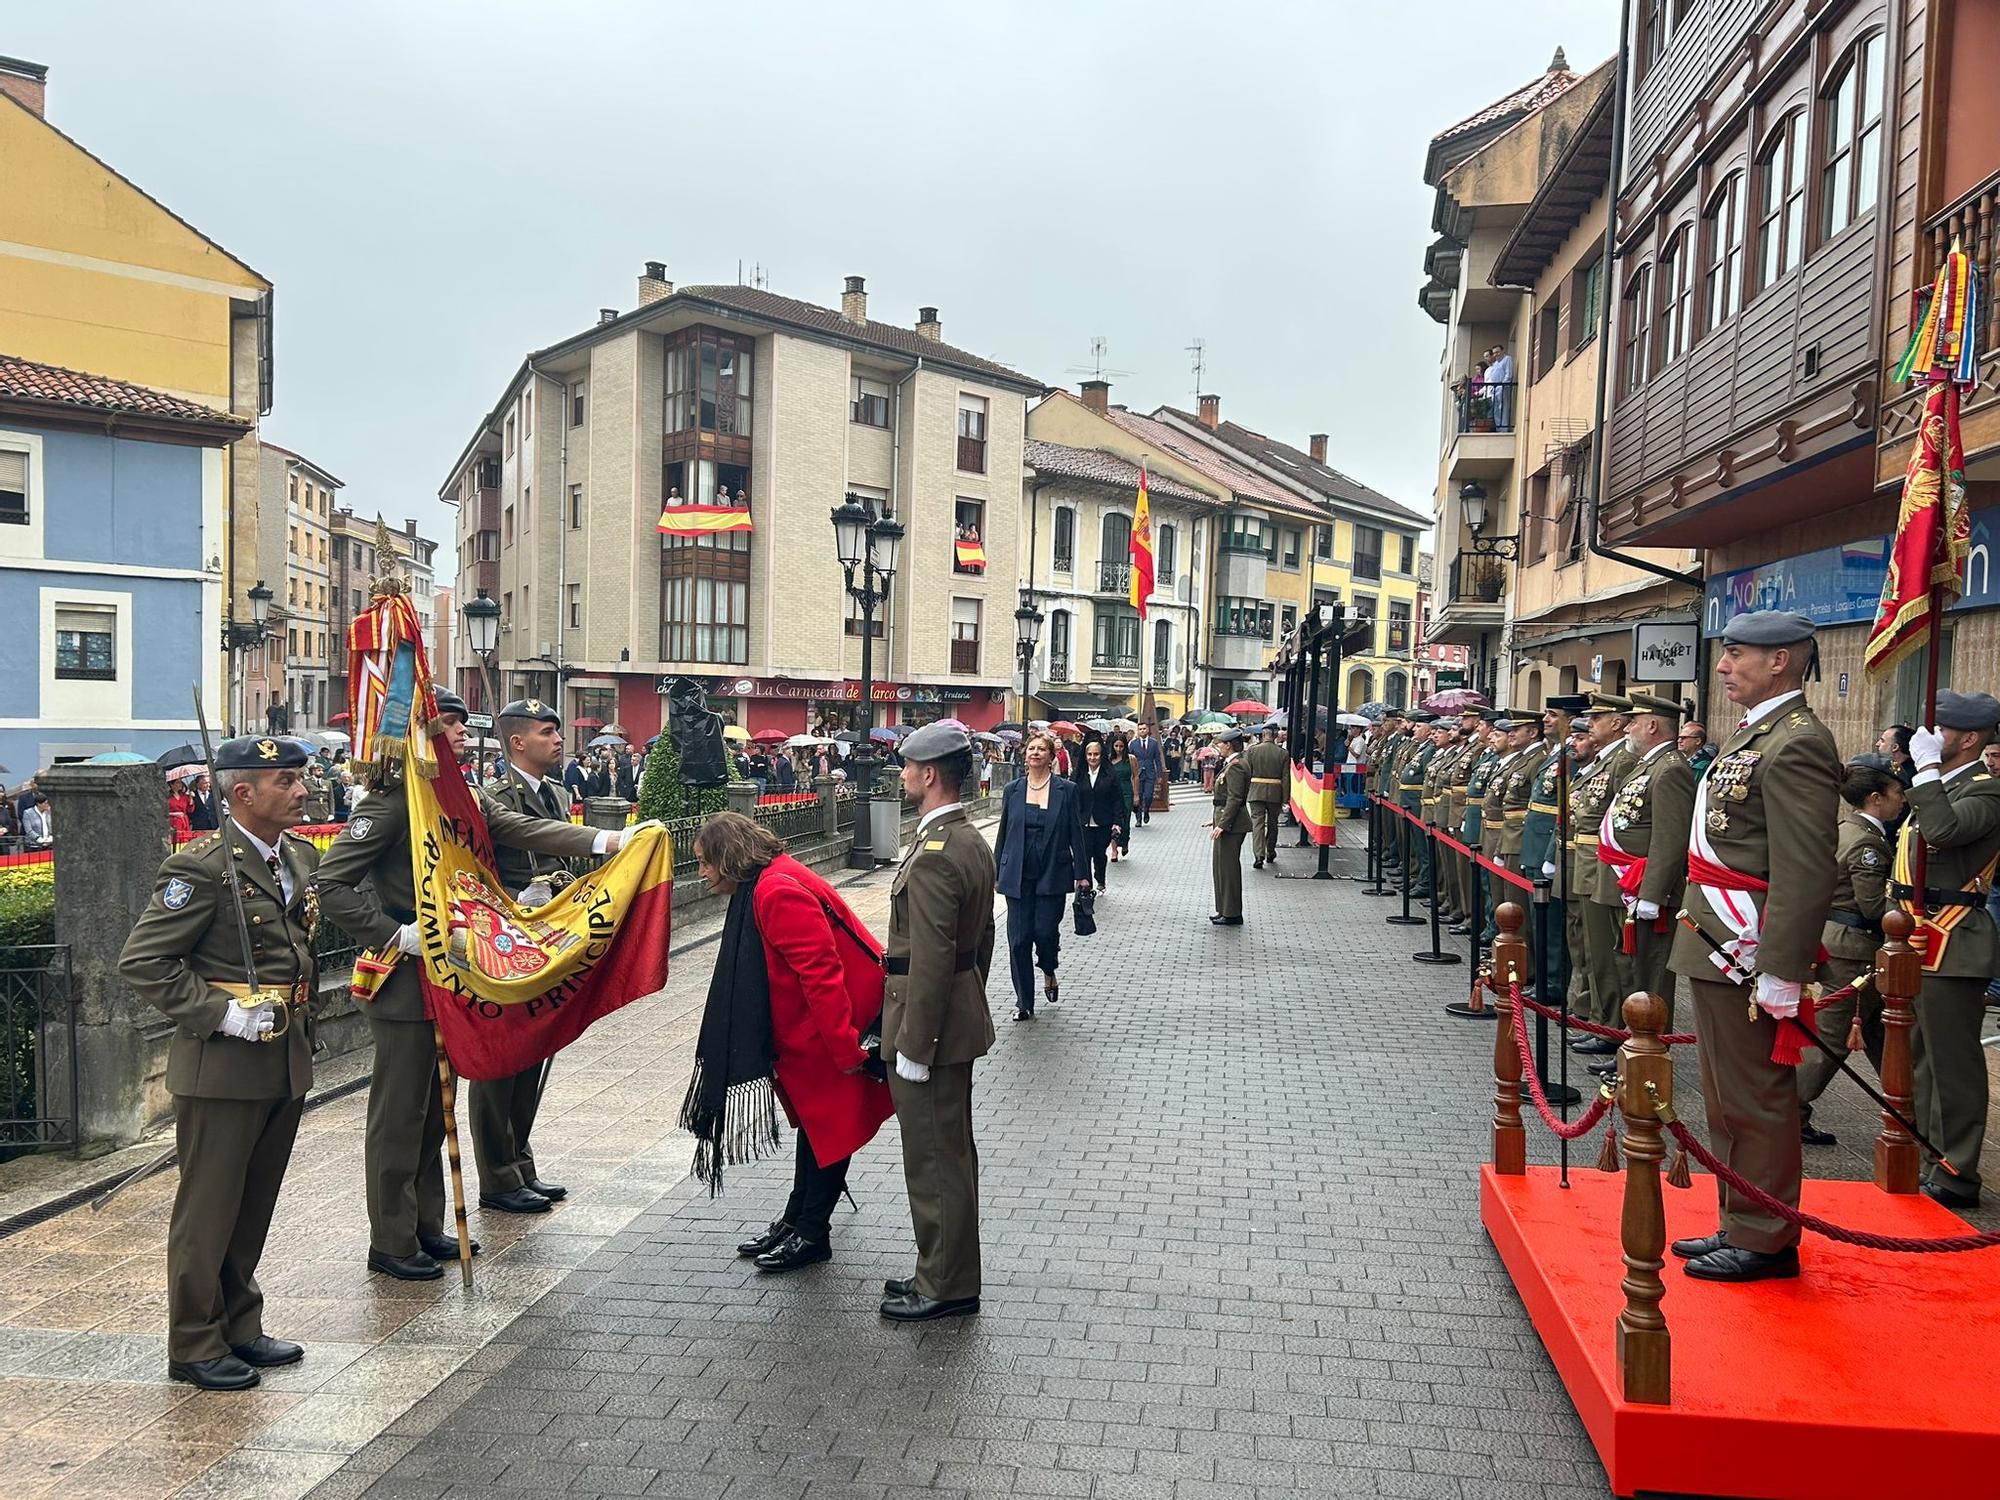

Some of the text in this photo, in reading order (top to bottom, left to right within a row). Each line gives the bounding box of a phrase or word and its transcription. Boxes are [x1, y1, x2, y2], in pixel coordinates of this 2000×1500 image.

[1641, 645, 1692, 661] HATCHET
[846, 684, 859, 698] de
[526, 888, 615, 1016] PRINCIPE
